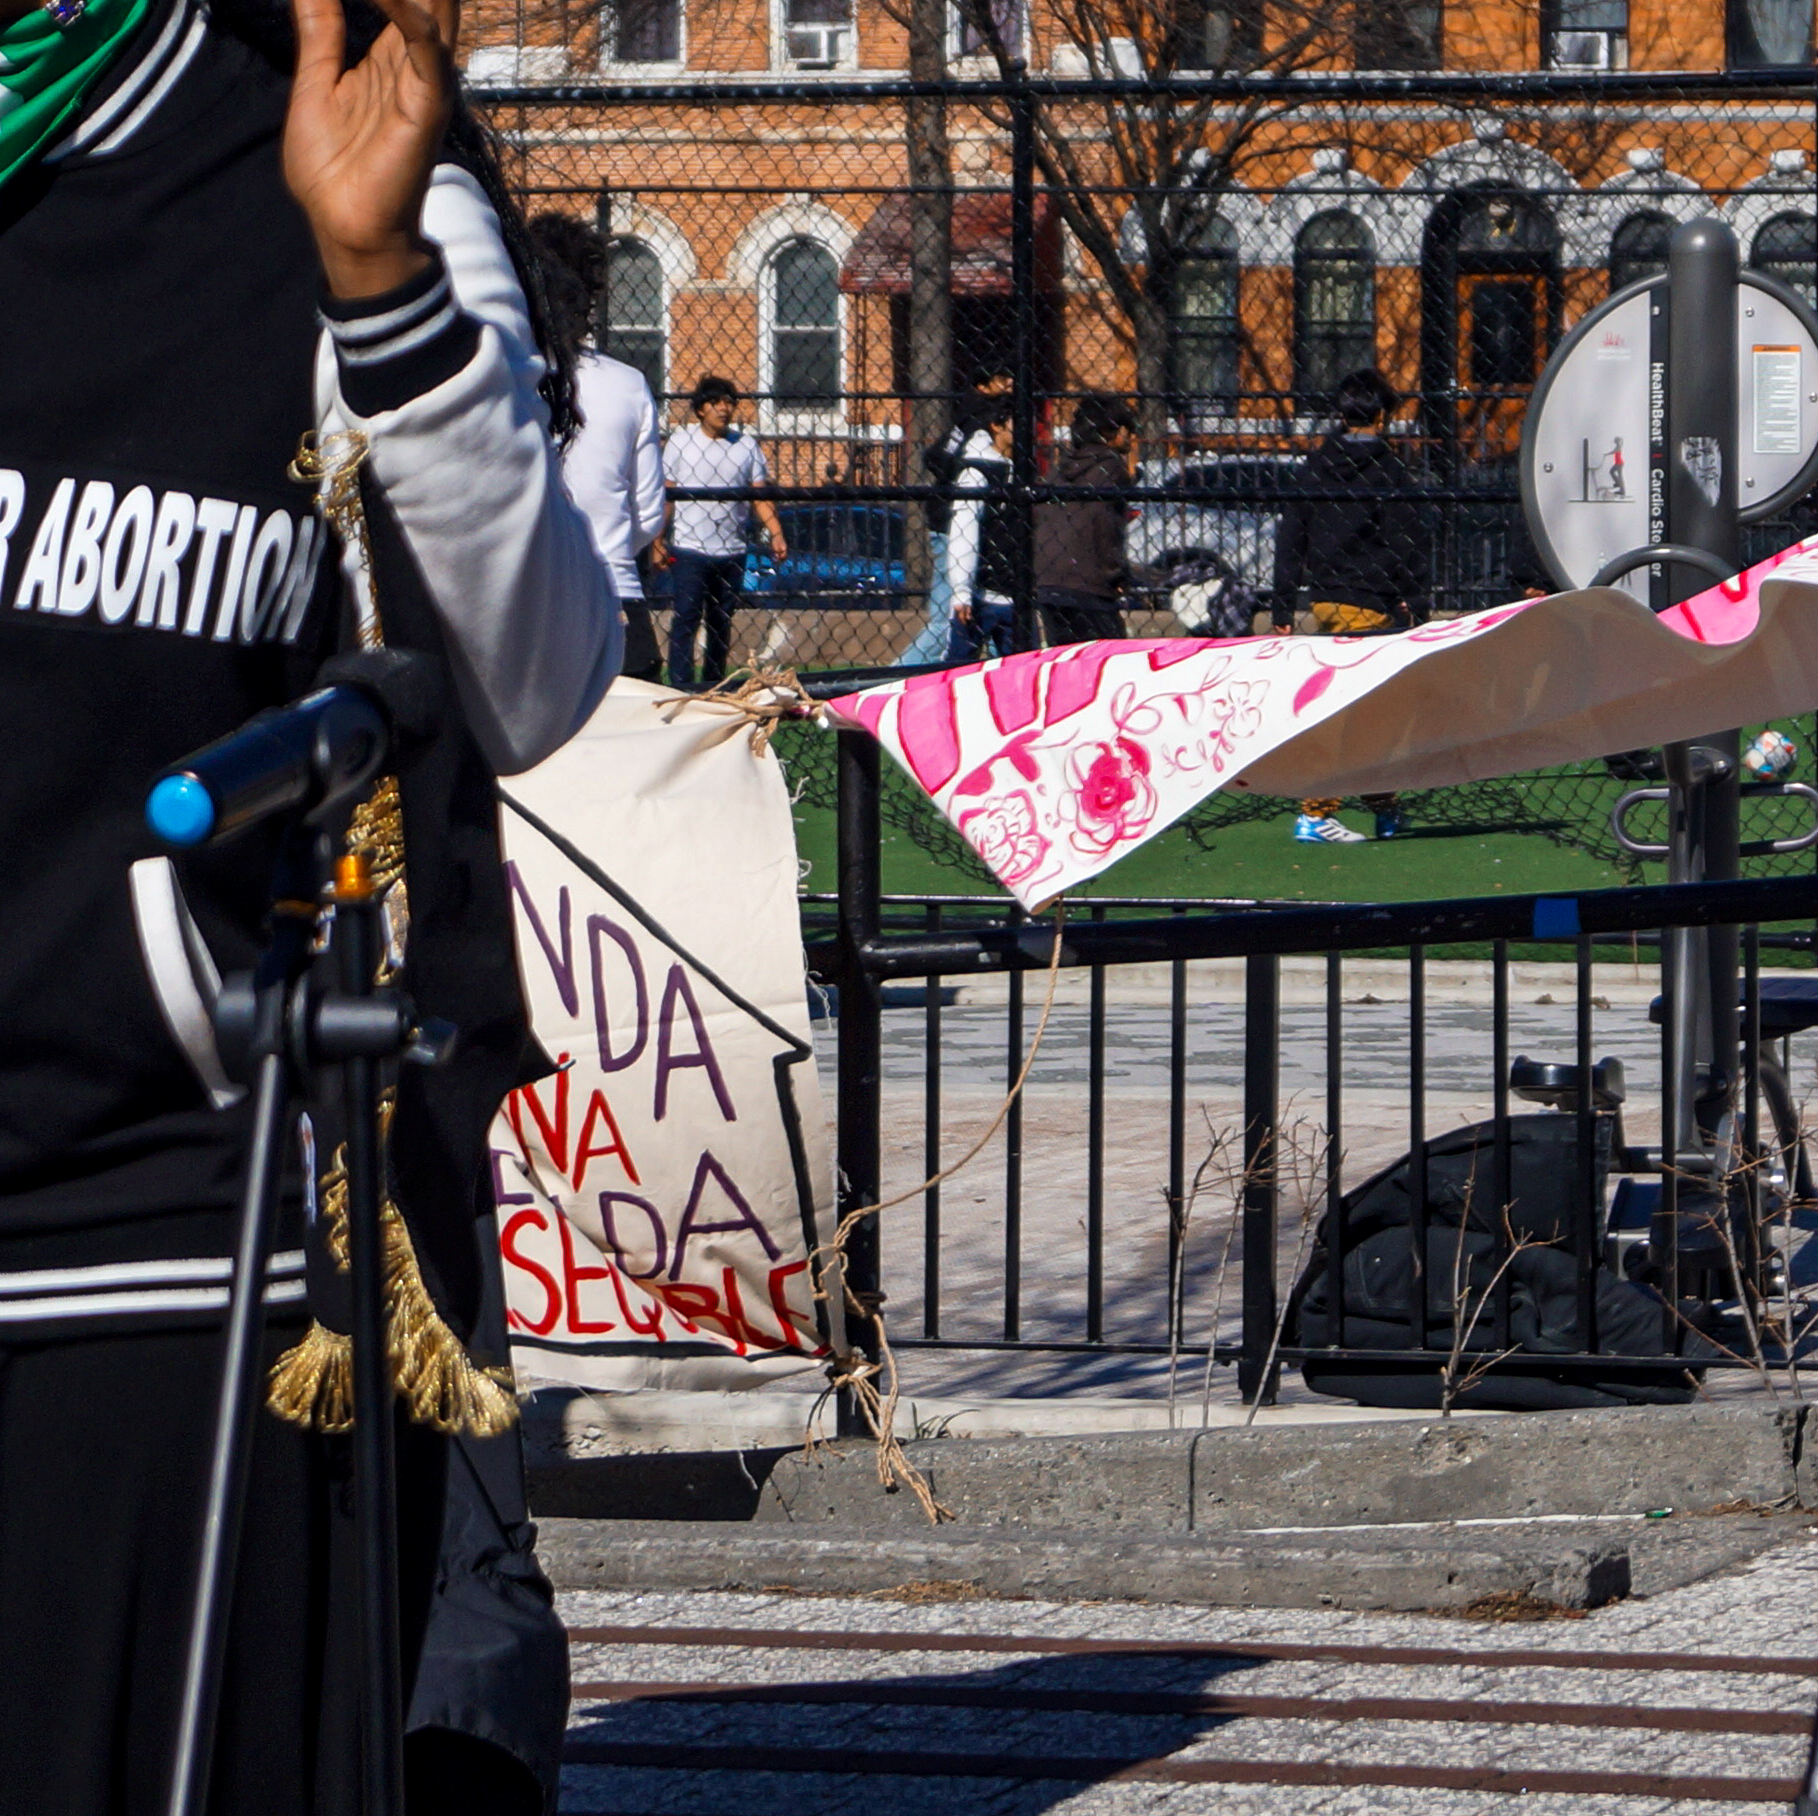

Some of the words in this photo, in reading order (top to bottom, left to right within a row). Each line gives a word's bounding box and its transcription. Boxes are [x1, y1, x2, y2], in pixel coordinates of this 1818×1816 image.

[1651, 362, 1665, 442] HealthBeat
[1651, 468, 1665, 517] Cardio
[13, 478, 328, 645] ABORTION
[1651, 519, 1665, 578] Steer
